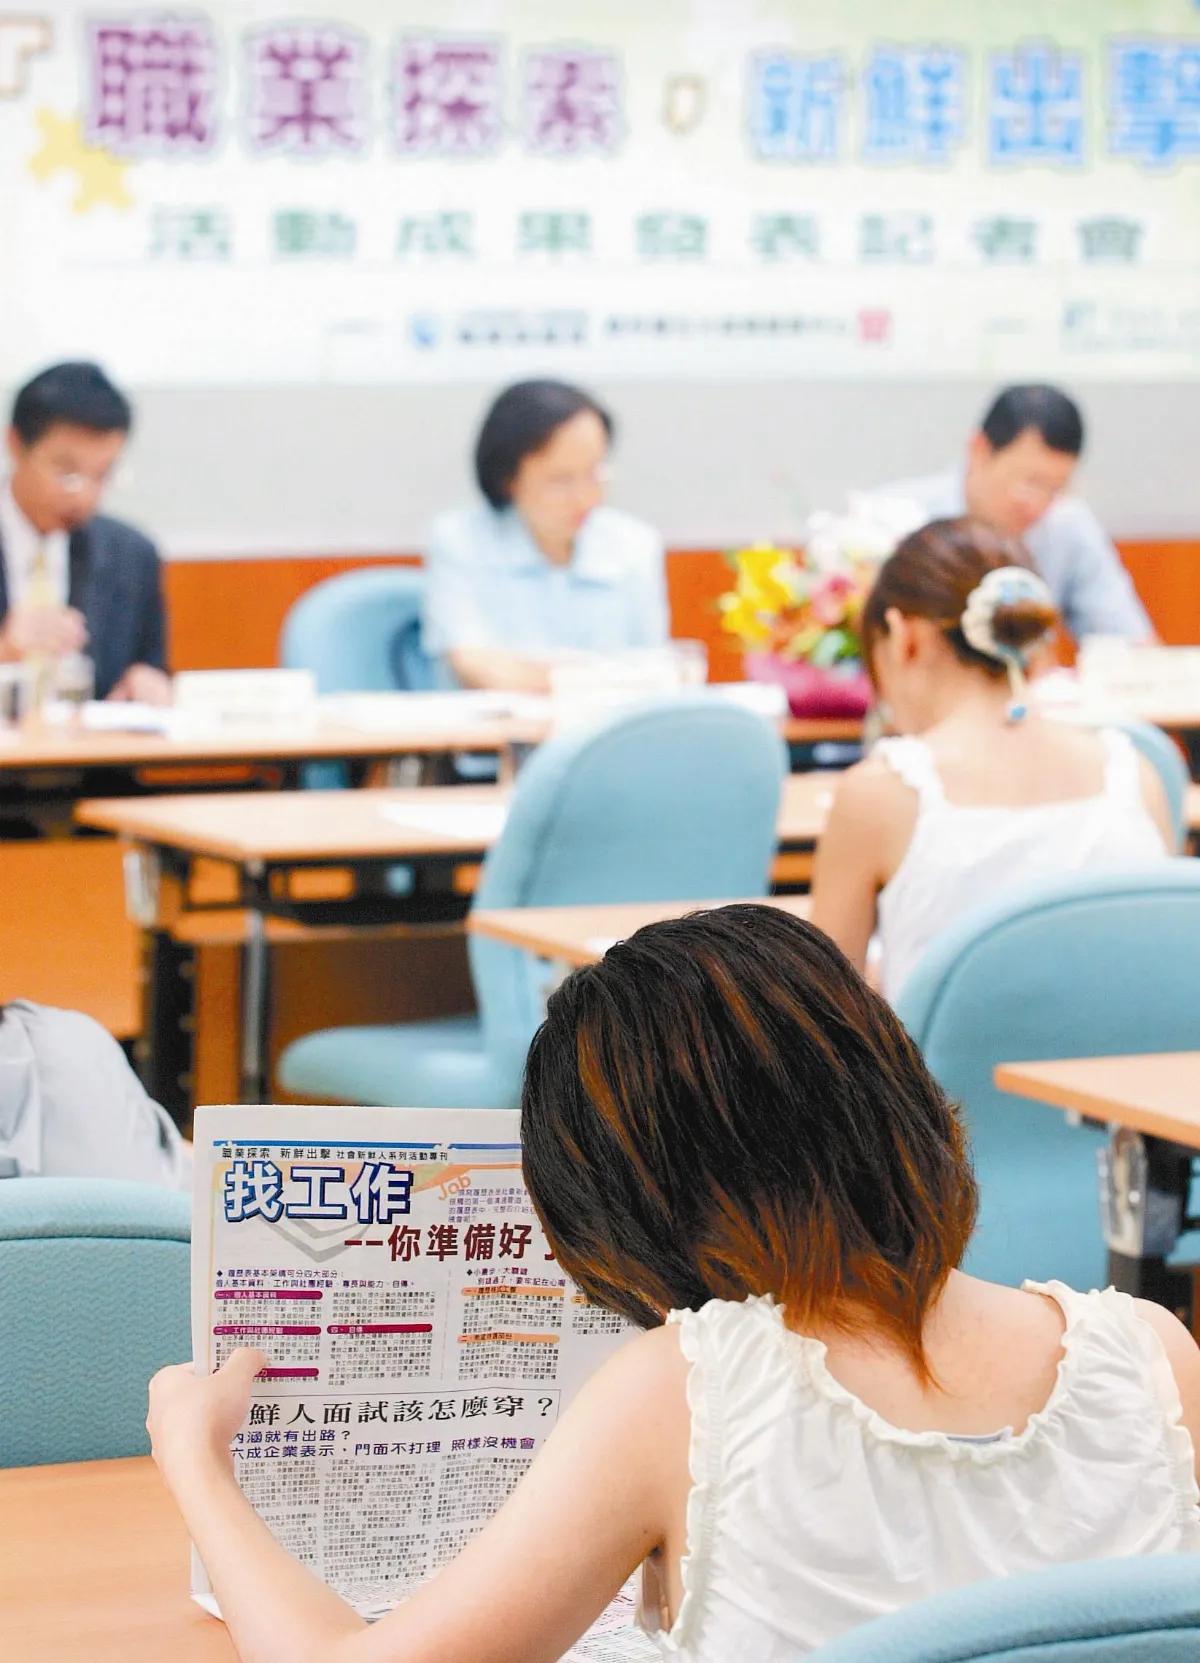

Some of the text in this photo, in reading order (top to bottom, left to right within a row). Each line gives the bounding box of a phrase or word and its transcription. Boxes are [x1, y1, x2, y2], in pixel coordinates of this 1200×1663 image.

[221, 1147, 448, 1161] 職業探索 新鮮出擊 社會新鮮人系列活動專刊
[223, 1160, 413, 1225] 找工作
[438, 1173, 471, 1201] Job
[248, 1395, 553, 1427] 鮮人面試該怎麼穿？
